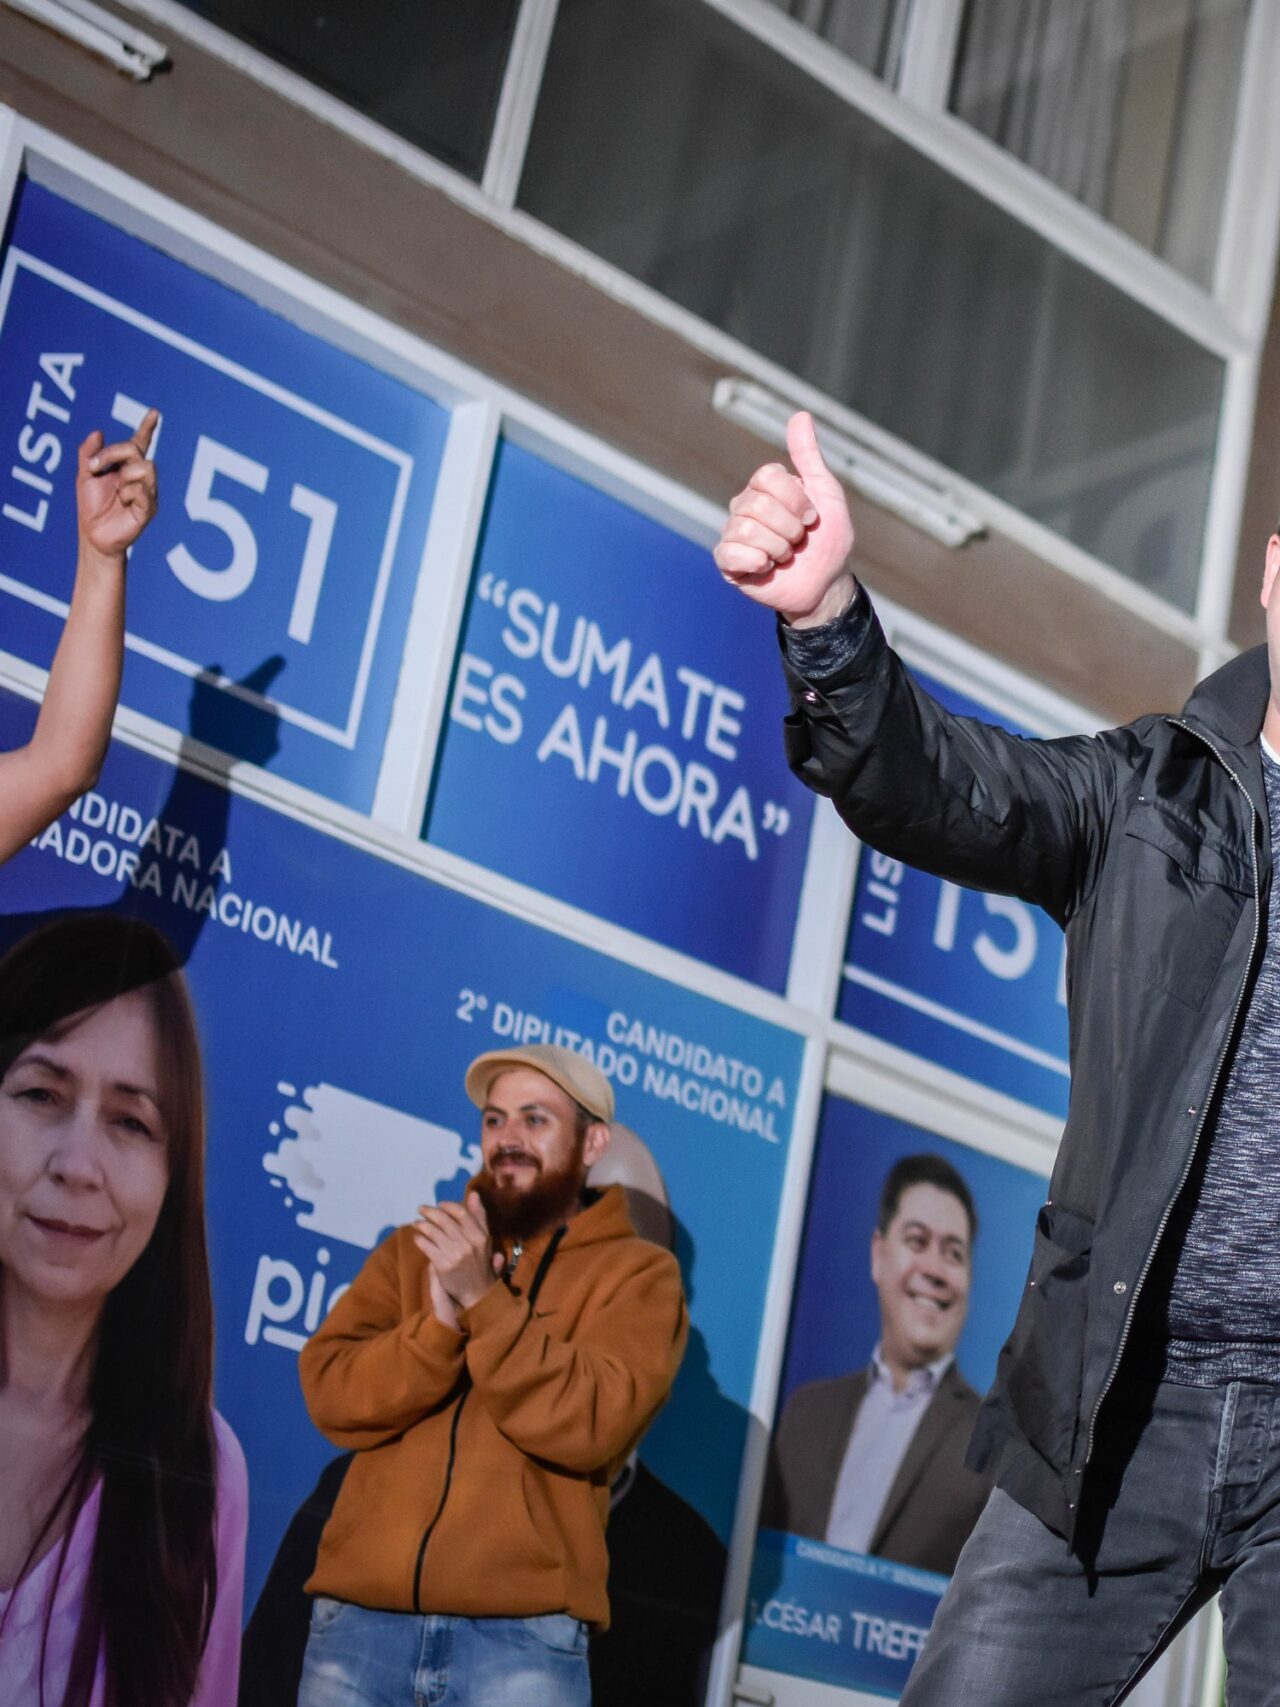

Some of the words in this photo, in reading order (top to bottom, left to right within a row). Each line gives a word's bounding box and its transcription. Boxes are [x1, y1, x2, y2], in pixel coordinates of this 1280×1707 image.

[2, 352, 85, 534] LISTA
[450, 651, 524, 743] ES
[209, 848, 232, 884] A
[861, 850, 905, 938] LIS
[171, 872, 338, 969] NACIONAL
[606, 1011, 763, 1098] CANDIDATO
[767, 1076, 787, 1110] A
[643, 1063, 780, 1144] NACIONAL
[245, 1246, 352, 1346] pi
